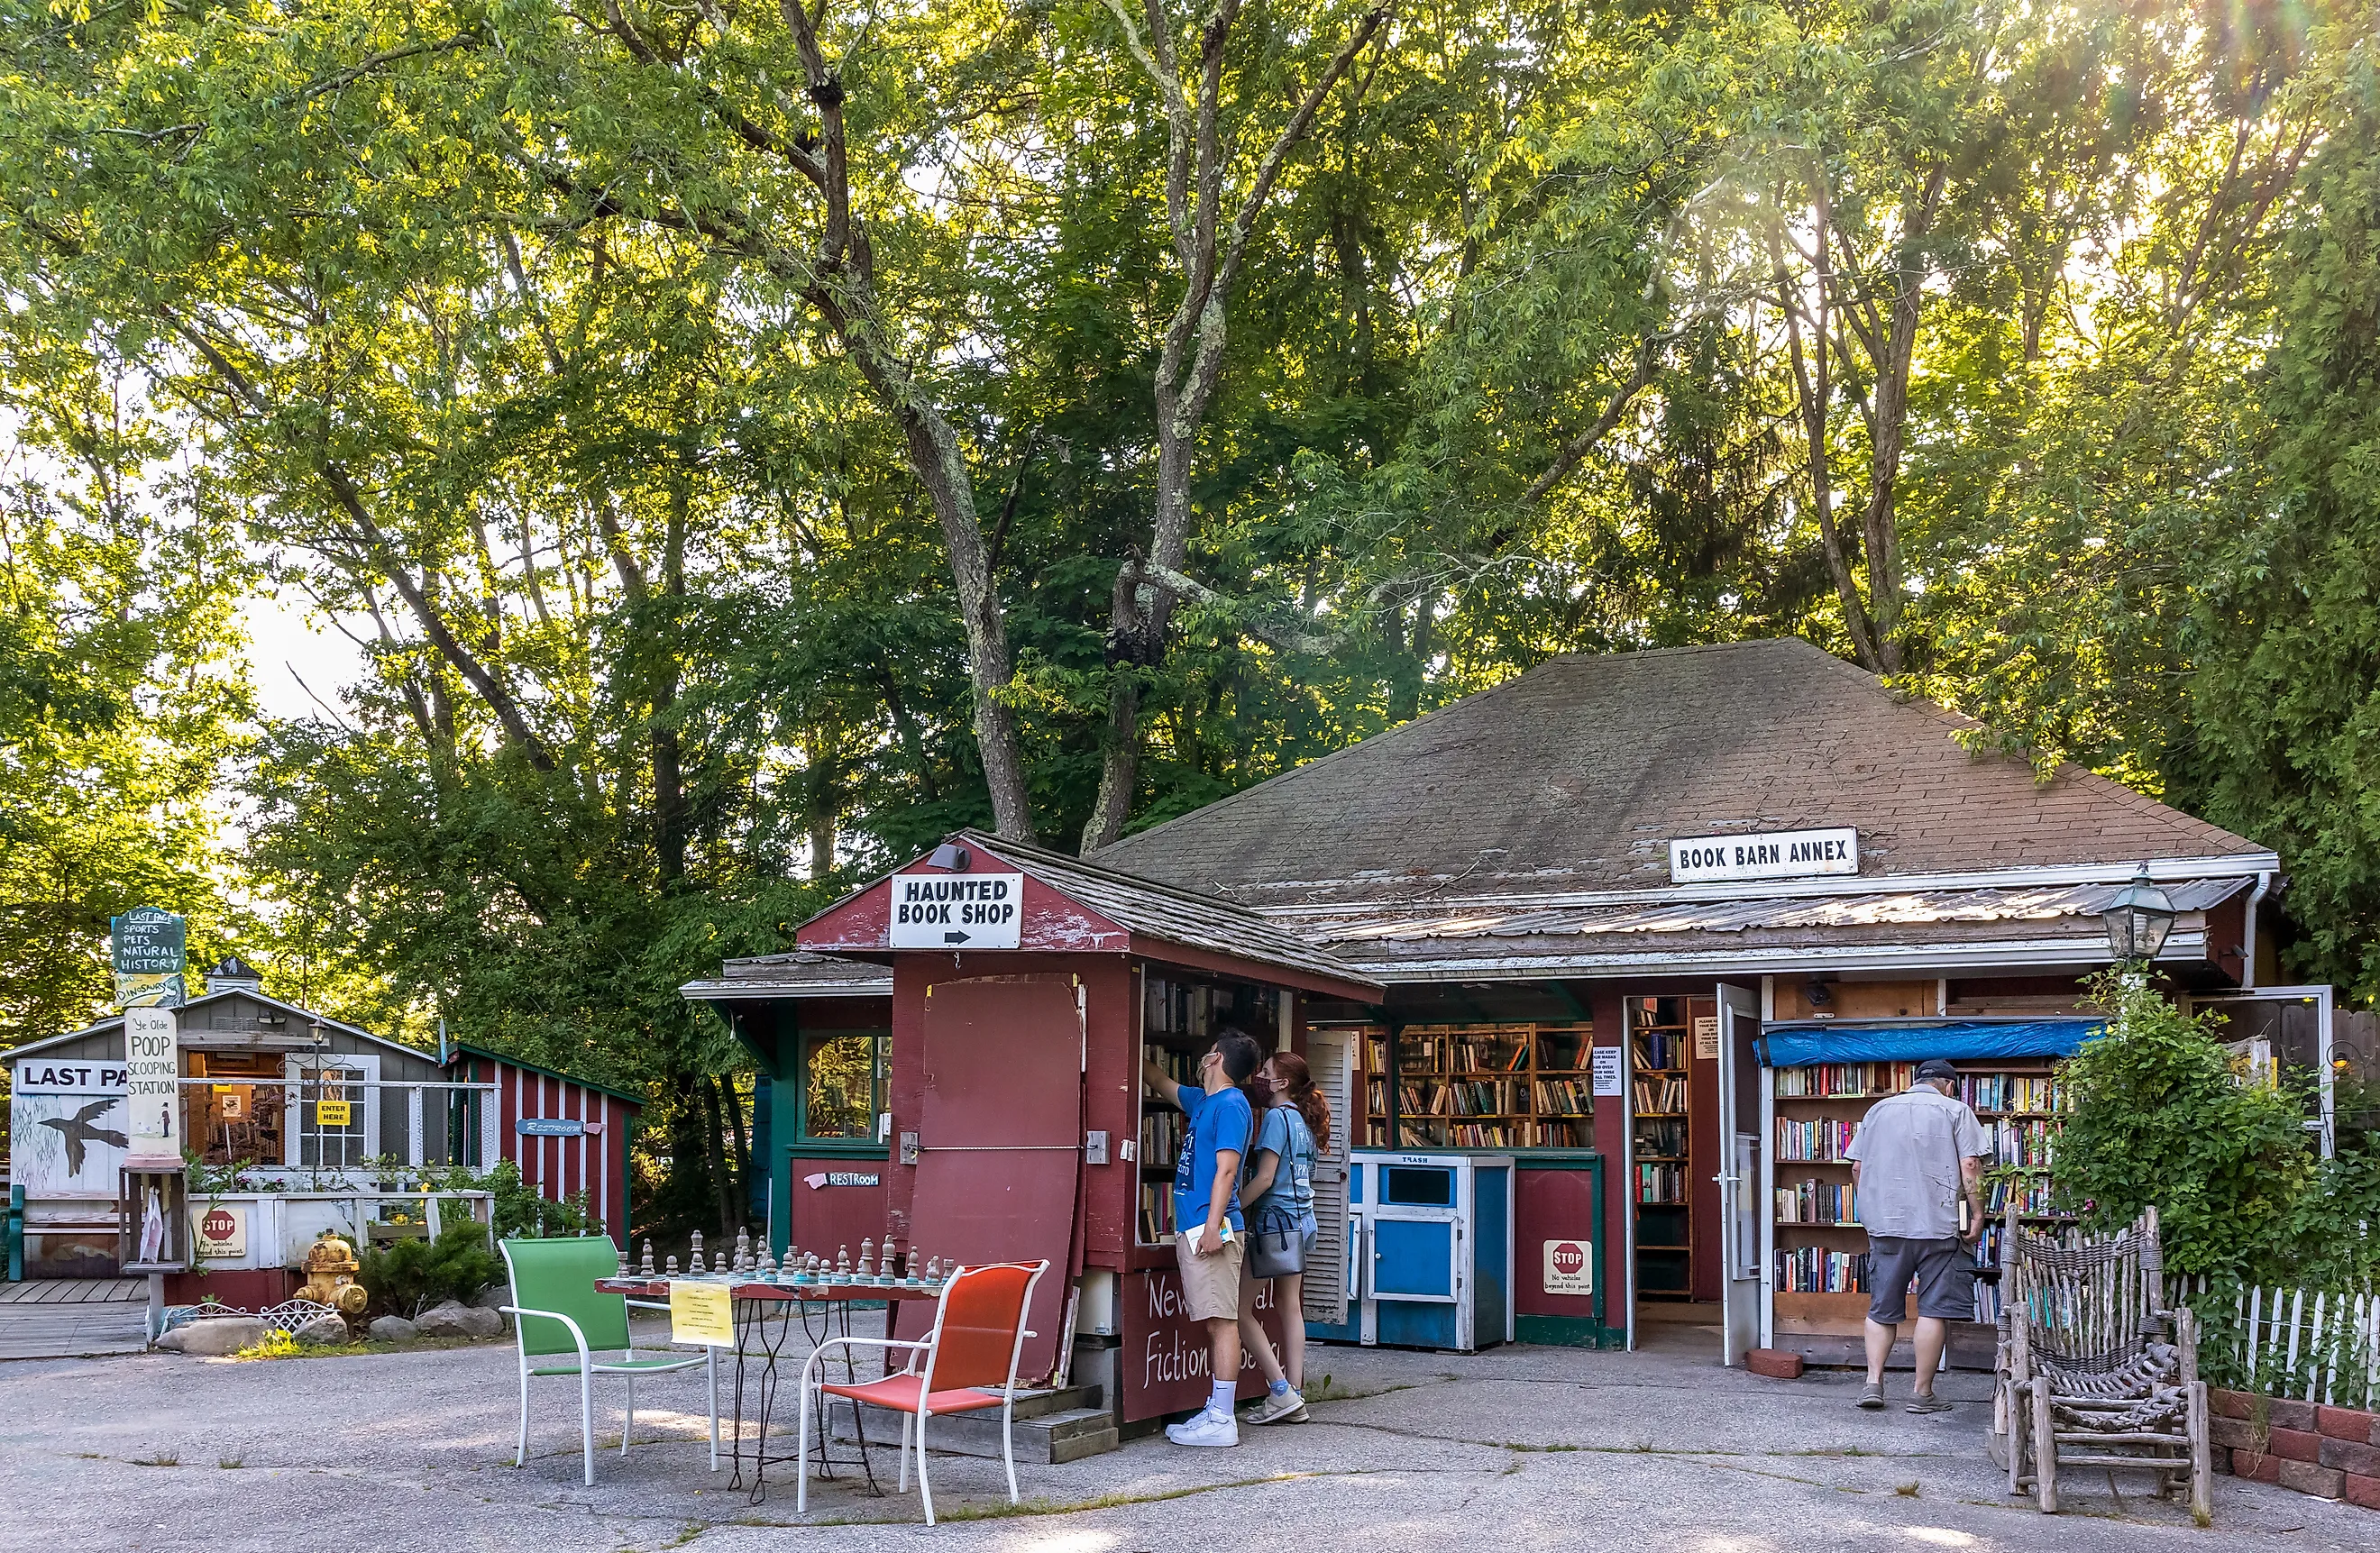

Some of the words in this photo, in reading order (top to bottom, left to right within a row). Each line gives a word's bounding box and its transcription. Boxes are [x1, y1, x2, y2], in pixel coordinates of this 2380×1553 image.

[1680, 847, 1726, 869] BOOK
[1735, 844, 1780, 866] BARN
[1790, 840, 1847, 863] ANNEX
[905, 881, 1008, 902] HAUNTED
[129, 912, 152, 921] LAST
[153, 913, 173, 922] PAGE
[898, 904, 952, 925] BOOK
[961, 904, 1014, 925] SHOP
[124, 925, 160, 934] SPORTS
[123, 936, 151, 945] PETS
[123, 946, 178, 957] NATURAL
[121, 958, 178, 971] HISTORY
[151, 1019, 168, 1030] Olde
[131, 1036, 170, 1056] POOP
[127, 1061, 176, 1076] SCOOPING
[24, 1067, 91, 1086] LAST
[128, 1080, 175, 1095] STATION
[526, 1122, 581, 1133] RESTROOM
[830, 1173, 879, 1186] RESTROOM
[203, 1220, 234, 1231] STOP
[1553, 1251, 1582, 1265] STOP
[1544, 1281, 1564, 1290] beyond
[1143, 1329, 1211, 1390] Fiction
